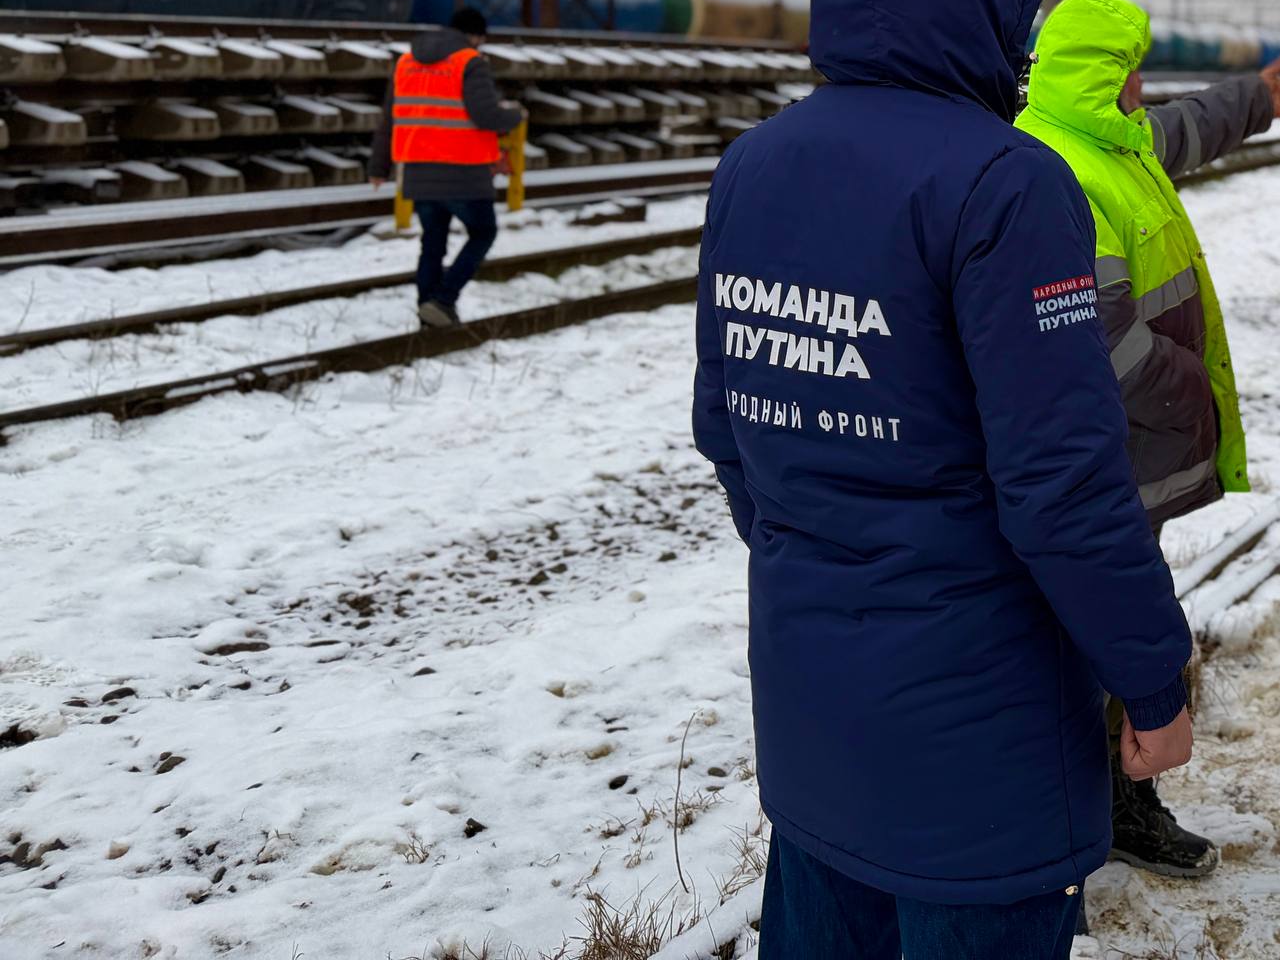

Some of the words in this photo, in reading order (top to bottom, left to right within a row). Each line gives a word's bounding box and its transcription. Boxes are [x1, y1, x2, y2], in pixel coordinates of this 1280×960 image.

[715, 273, 892, 337] КОМАНДА
[1039, 306, 1097, 332] ПУТИНА
[726, 322, 871, 379] ПУТИНА
[726, 387, 802, 429] РОДНЫЙ
[818, 409, 901, 441] ФРОНТ
